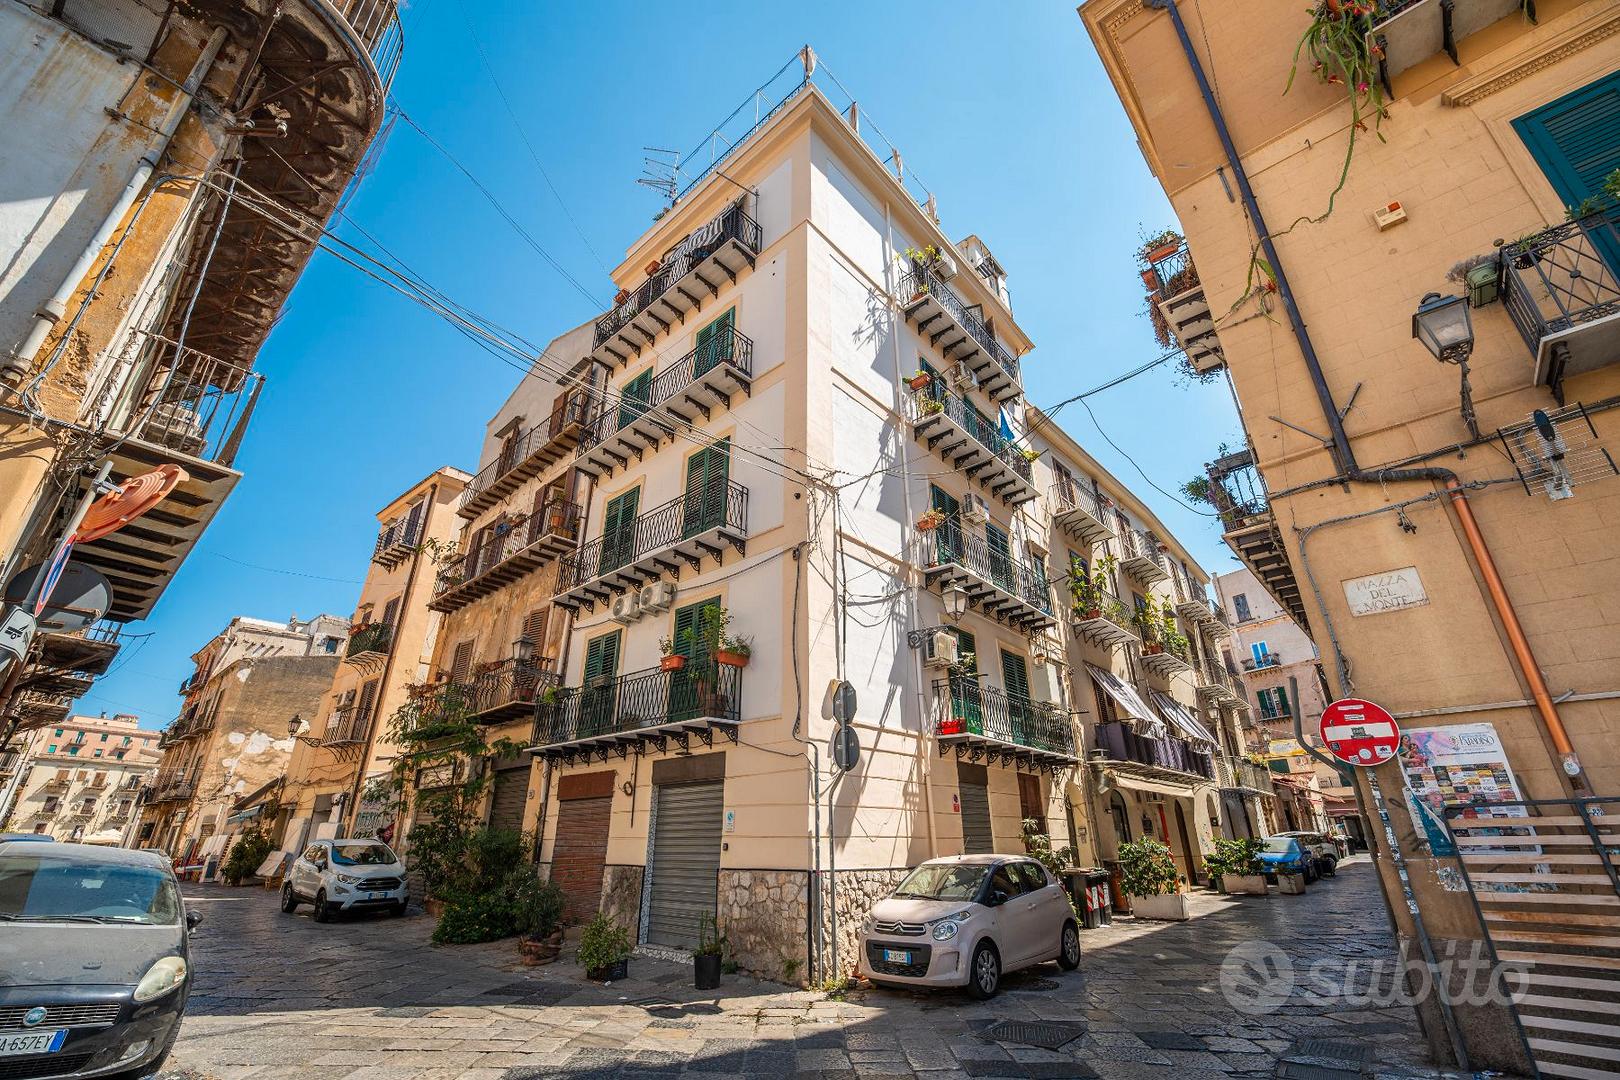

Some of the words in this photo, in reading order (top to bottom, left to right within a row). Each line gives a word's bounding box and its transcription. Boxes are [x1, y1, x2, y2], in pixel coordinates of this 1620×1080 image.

[1355, 575, 1407, 591] PIAZZA
[1369, 587, 1397, 600] DEL
[1363, 595, 1408, 611] MONTE
